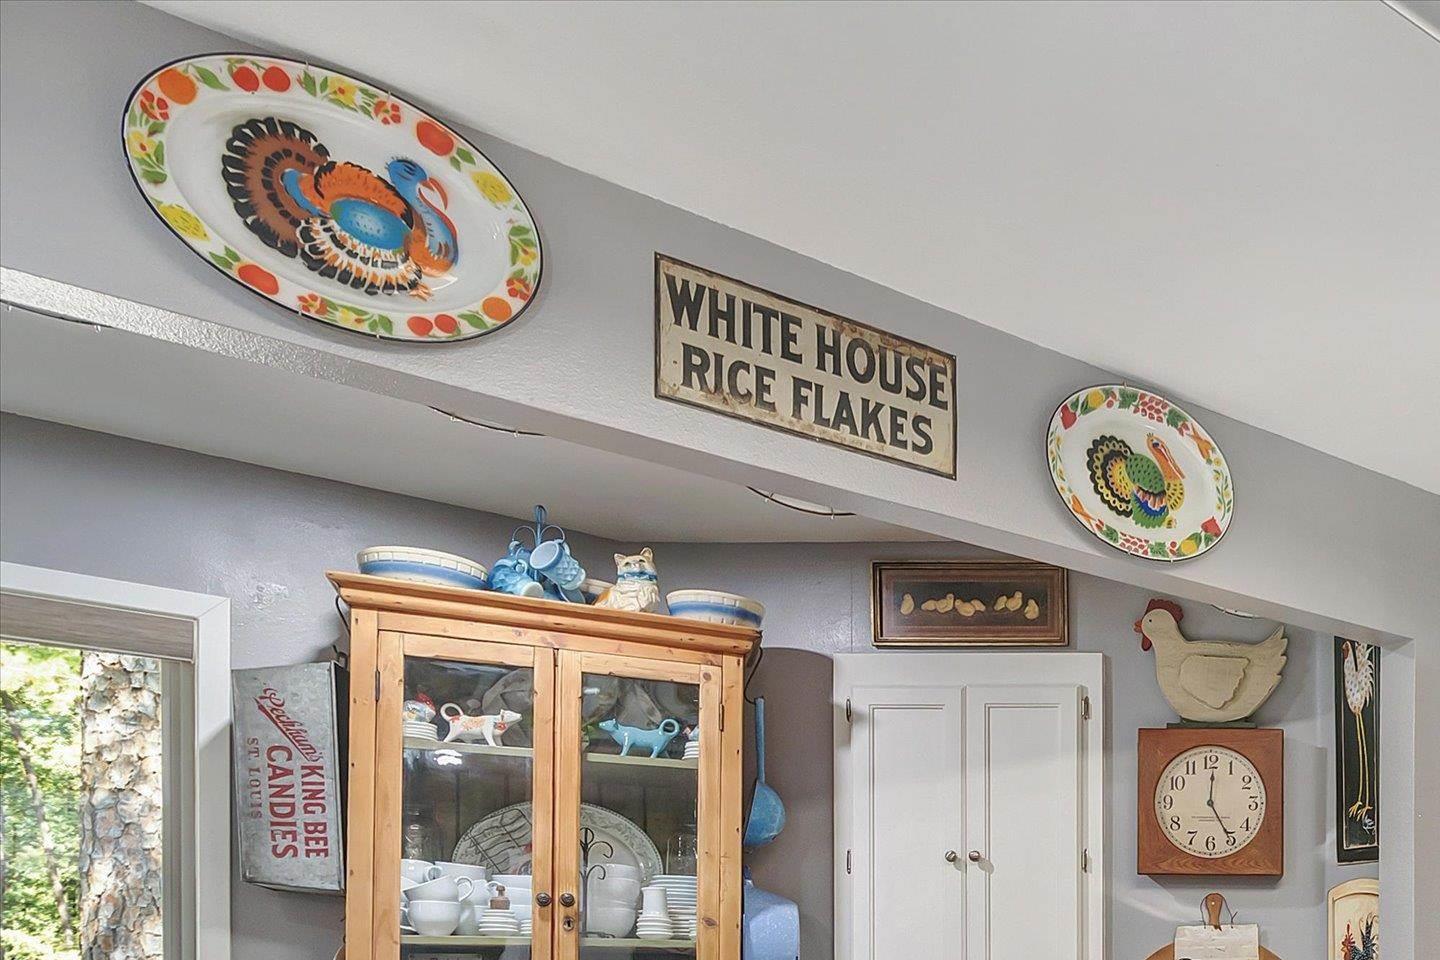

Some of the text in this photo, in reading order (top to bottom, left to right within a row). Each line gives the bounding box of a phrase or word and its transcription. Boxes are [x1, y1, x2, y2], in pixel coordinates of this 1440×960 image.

[664, 272, 949, 410] WHITE HOUSE
[681, 343, 934, 455] RICE FLAKES
[1185, 761, 1196, 775] 11
[1203, 755, 1219, 769] 12
[1228, 761, 1233, 775] 1
[1170, 775, 1185, 791] 10
[1242, 775, 1251, 790] 2
[266, 745, 298, 858] CANDIES
[1163, 795, 1173, 810] 9
[1248, 796, 1258, 811] 3
[301, 765, 329, 858] KING BEE
[1170, 816, 1180, 831] 8
[1240, 817, 1250, 831] 4
[1187, 831, 1198, 845] 7
[1206, 836, 1215, 851] 6
[1226, 831, 1236, 846] 5
